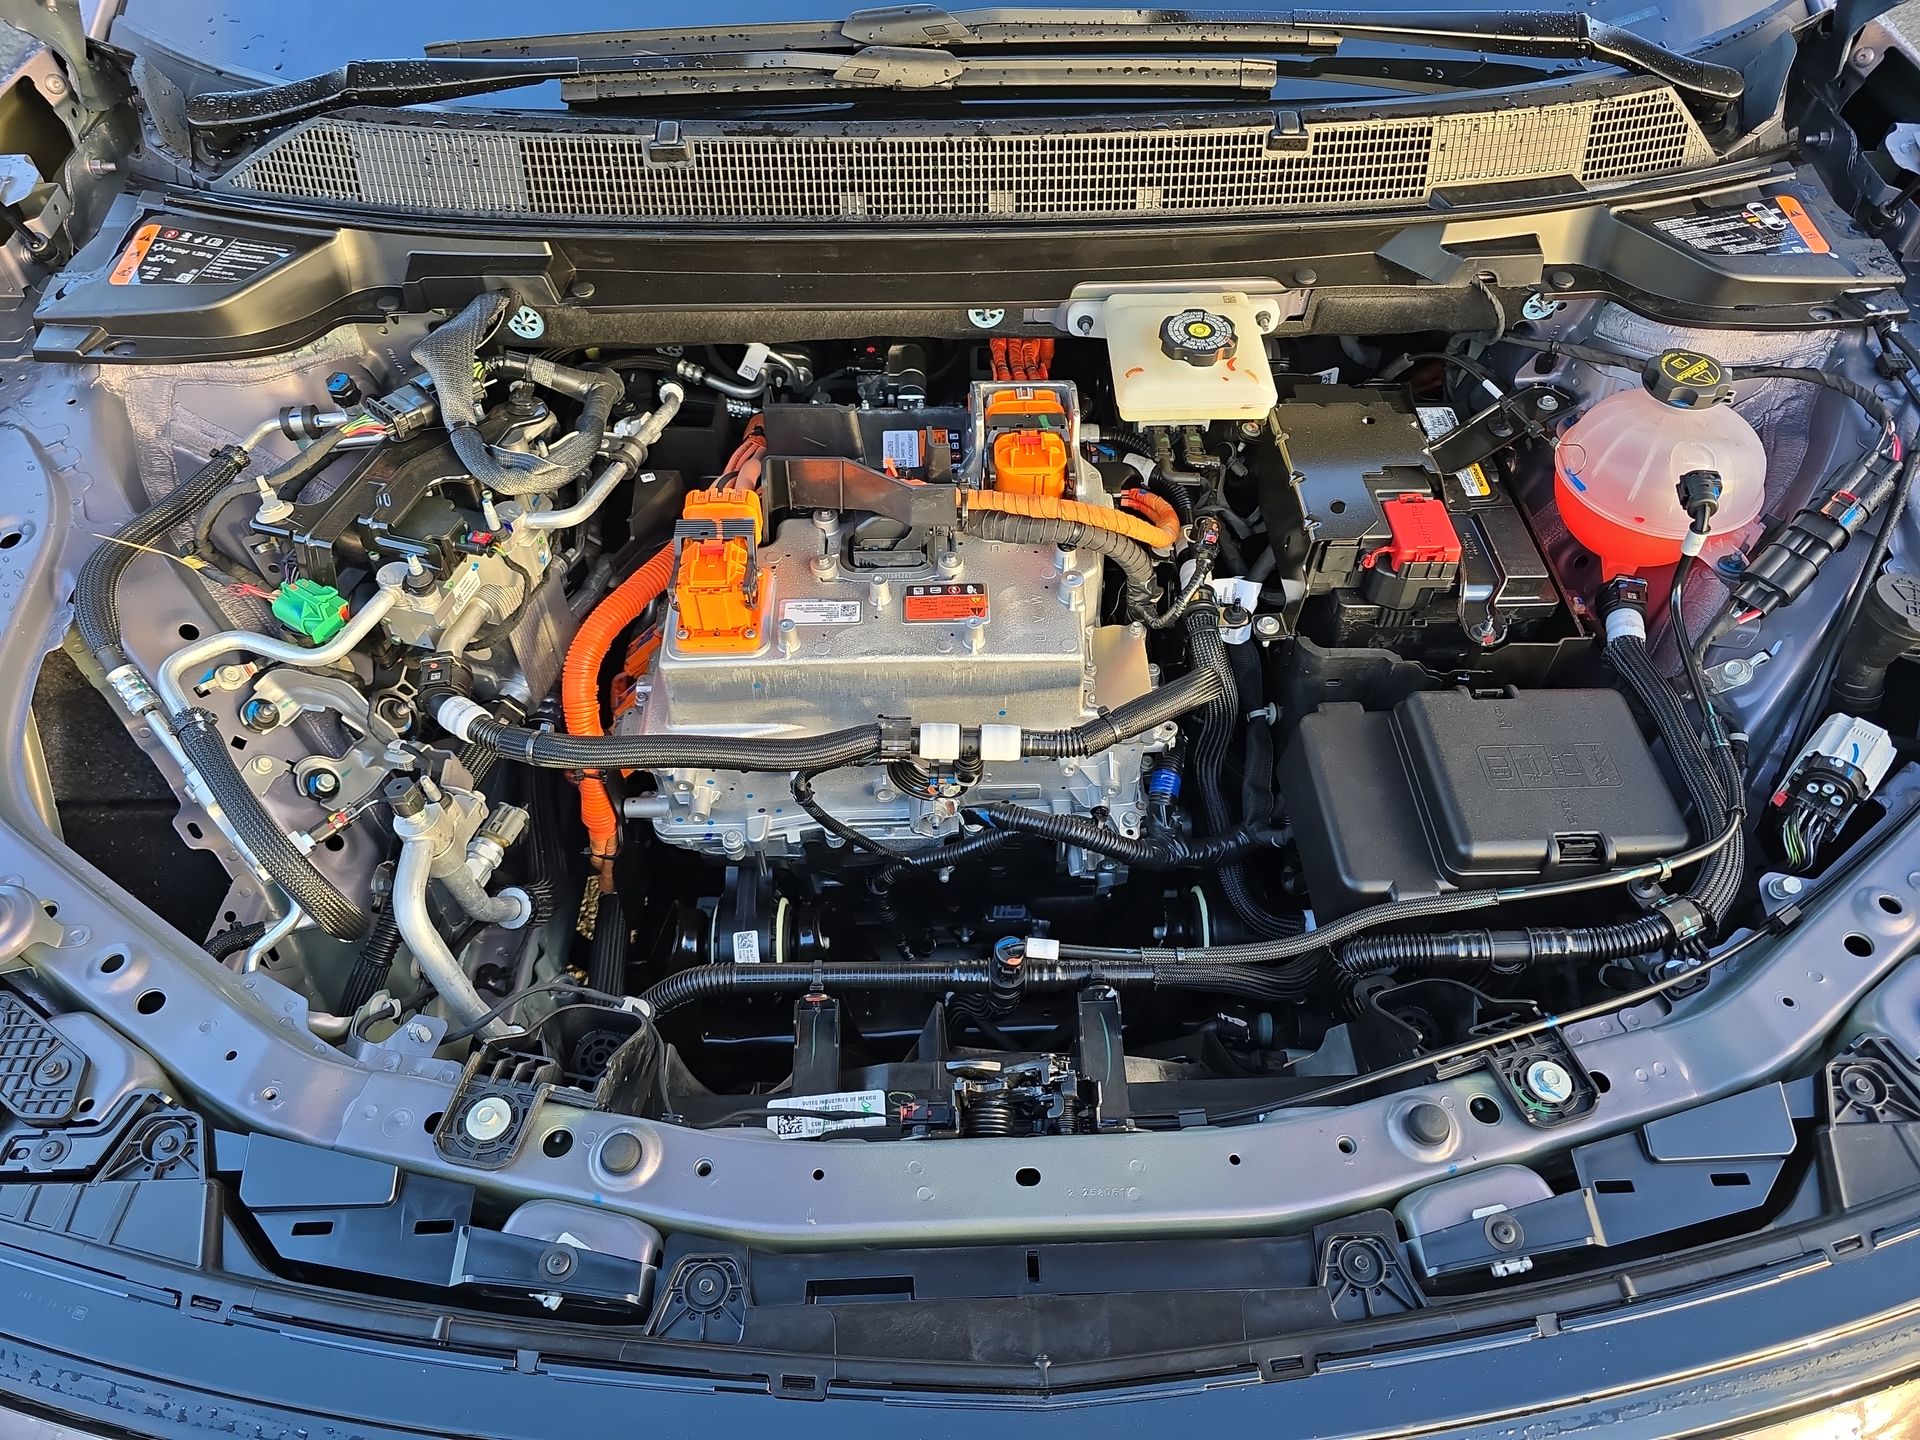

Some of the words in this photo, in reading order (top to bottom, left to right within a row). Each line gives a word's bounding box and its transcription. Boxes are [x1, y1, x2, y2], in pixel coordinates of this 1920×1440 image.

[1676, 361, 1709, 381] ACDelco
[1472, 465, 1484, 487] POISON
[819, 1097, 848, 1105] INDUSTRIES
